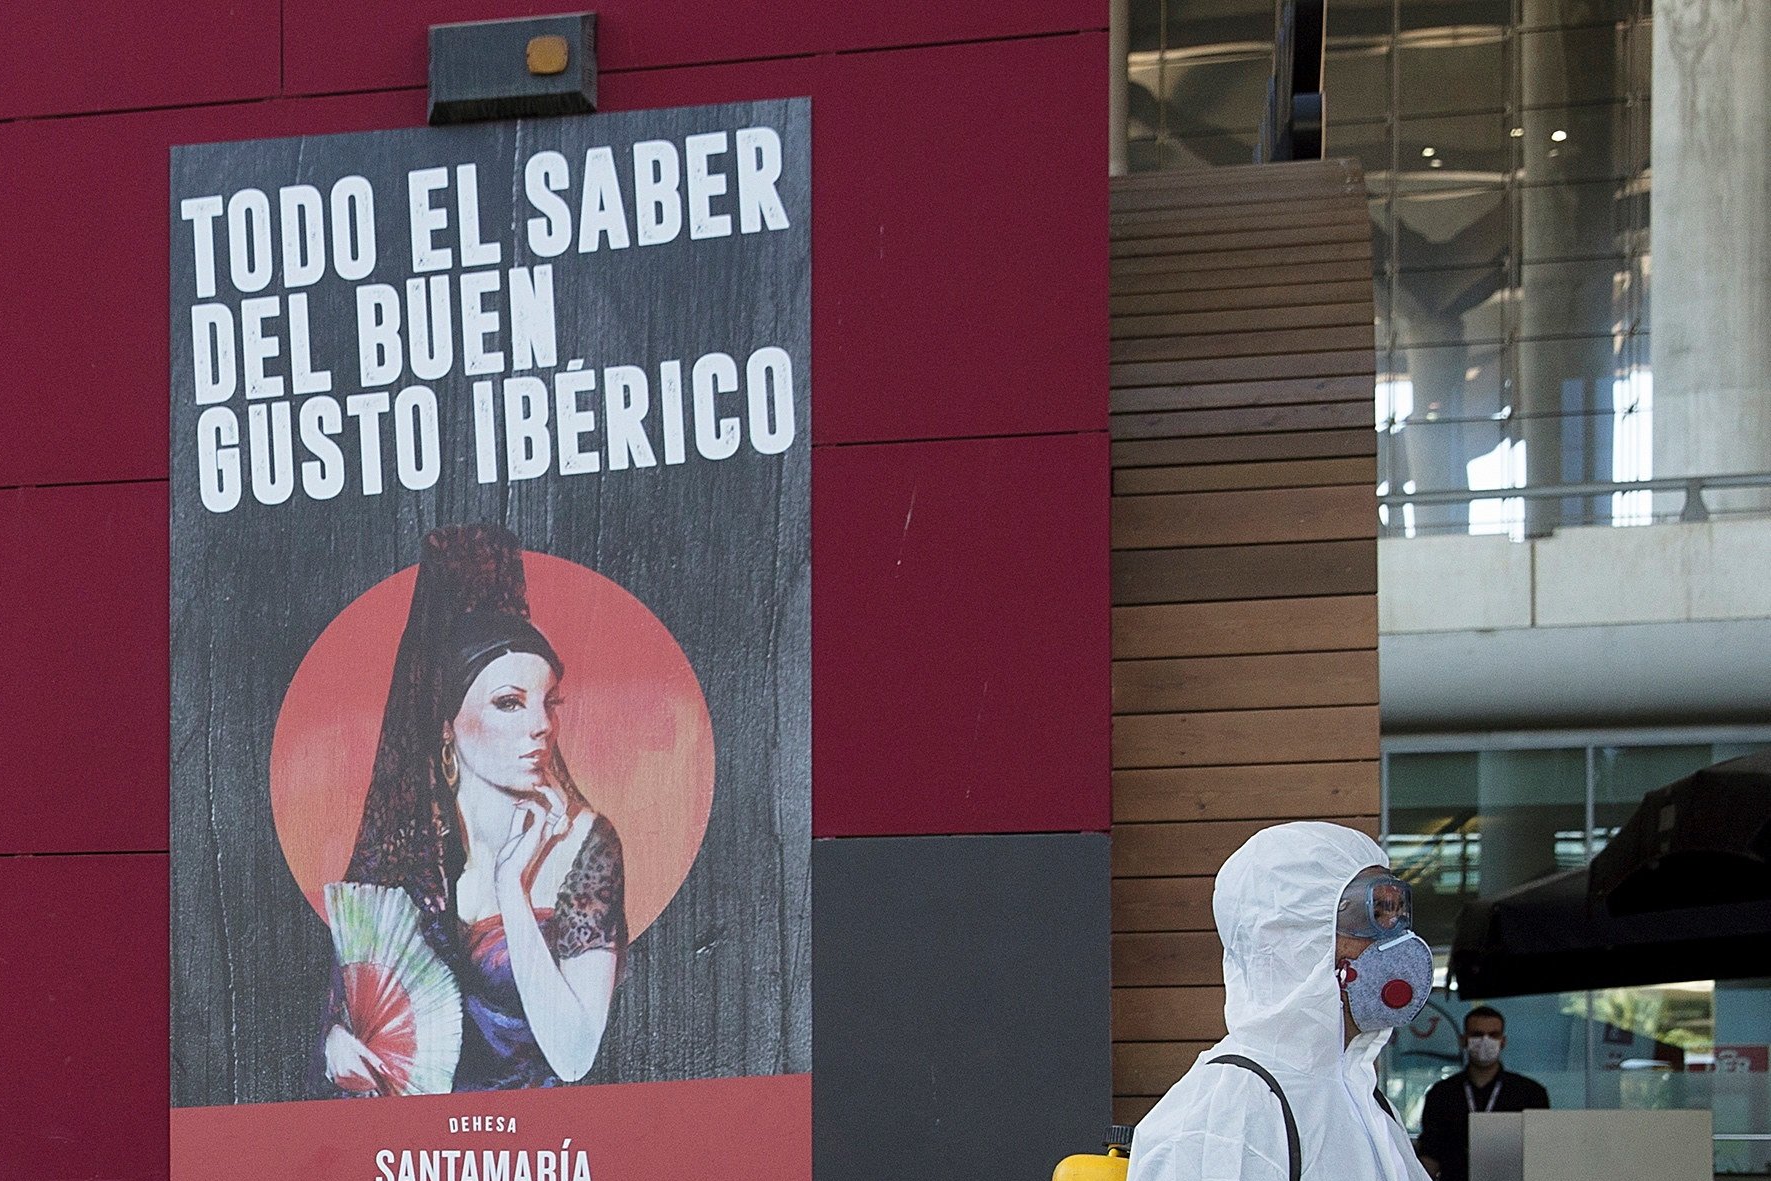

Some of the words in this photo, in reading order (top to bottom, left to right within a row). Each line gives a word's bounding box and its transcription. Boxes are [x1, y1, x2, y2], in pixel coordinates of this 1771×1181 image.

[181, 176, 376, 298] TODO
[408, 164, 501, 272] EL
[525, 127, 790, 257] SABER
[192, 293, 331, 405] DEL
[356, 263, 557, 387] BUEN
[198, 385, 440, 513] GUSTO
[473, 347, 795, 485] IBÉRICO
[449, 1115, 517, 1134] DEHESA
